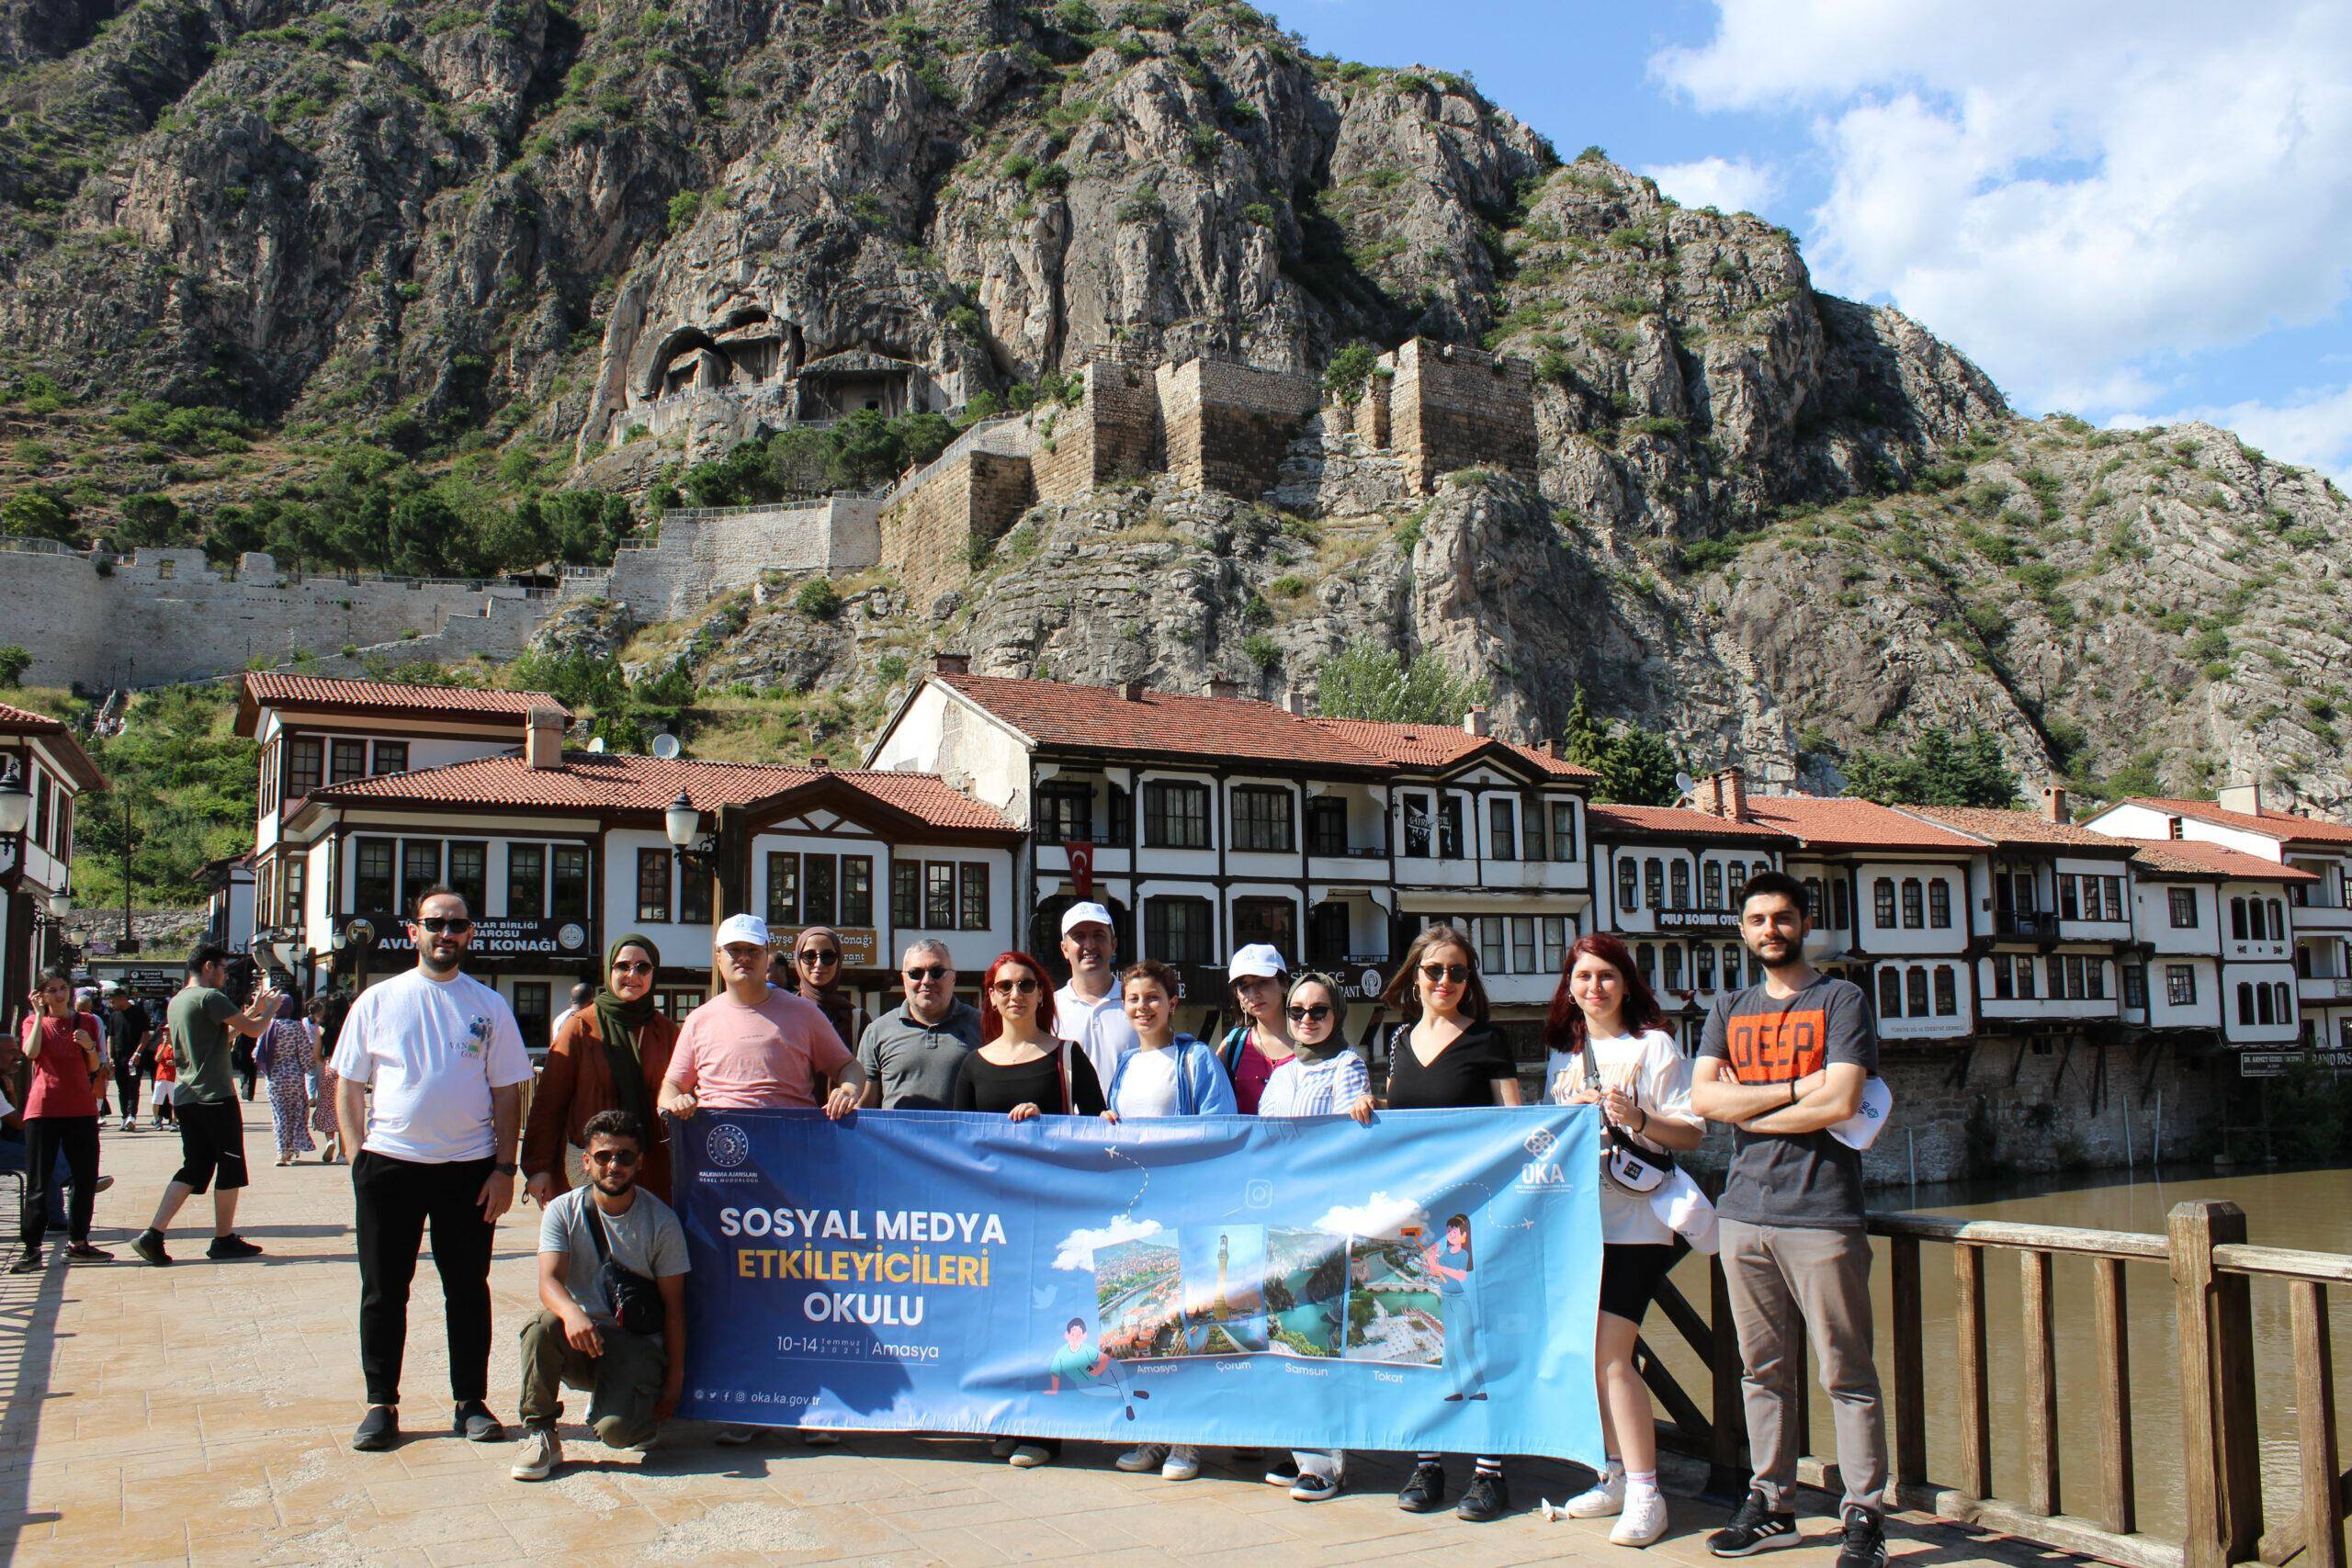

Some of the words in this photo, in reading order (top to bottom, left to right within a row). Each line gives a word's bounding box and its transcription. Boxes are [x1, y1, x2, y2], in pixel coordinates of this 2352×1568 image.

[500, 920, 538, 930] BİRLİĞİ
[490, 937, 557, 952] KONAĞI
[1735, 1022, 1814, 1067] DEEP
[1521, 1162, 1566, 1184] OKA
[720, 1207, 866, 1240] SOSYAL
[876, 1211, 1007, 1245] MEDYA
[738, 1242, 989, 1287] ETKİLEYİCİLERİ
[803, 1292, 924, 1325] OKULU
[777, 1336, 818, 1352] 10-14
[872, 1341, 939, 1361] Amasya
[1136, 1362, 1178, 1376] Amasya
[1216, 1360, 1251, 1374] Çorum
[1284, 1362, 1329, 1377] Samsun
[1373, 1370, 1404, 1384] Tokat
[751, 1391, 821, 1407] oka.ka.gov.tr
